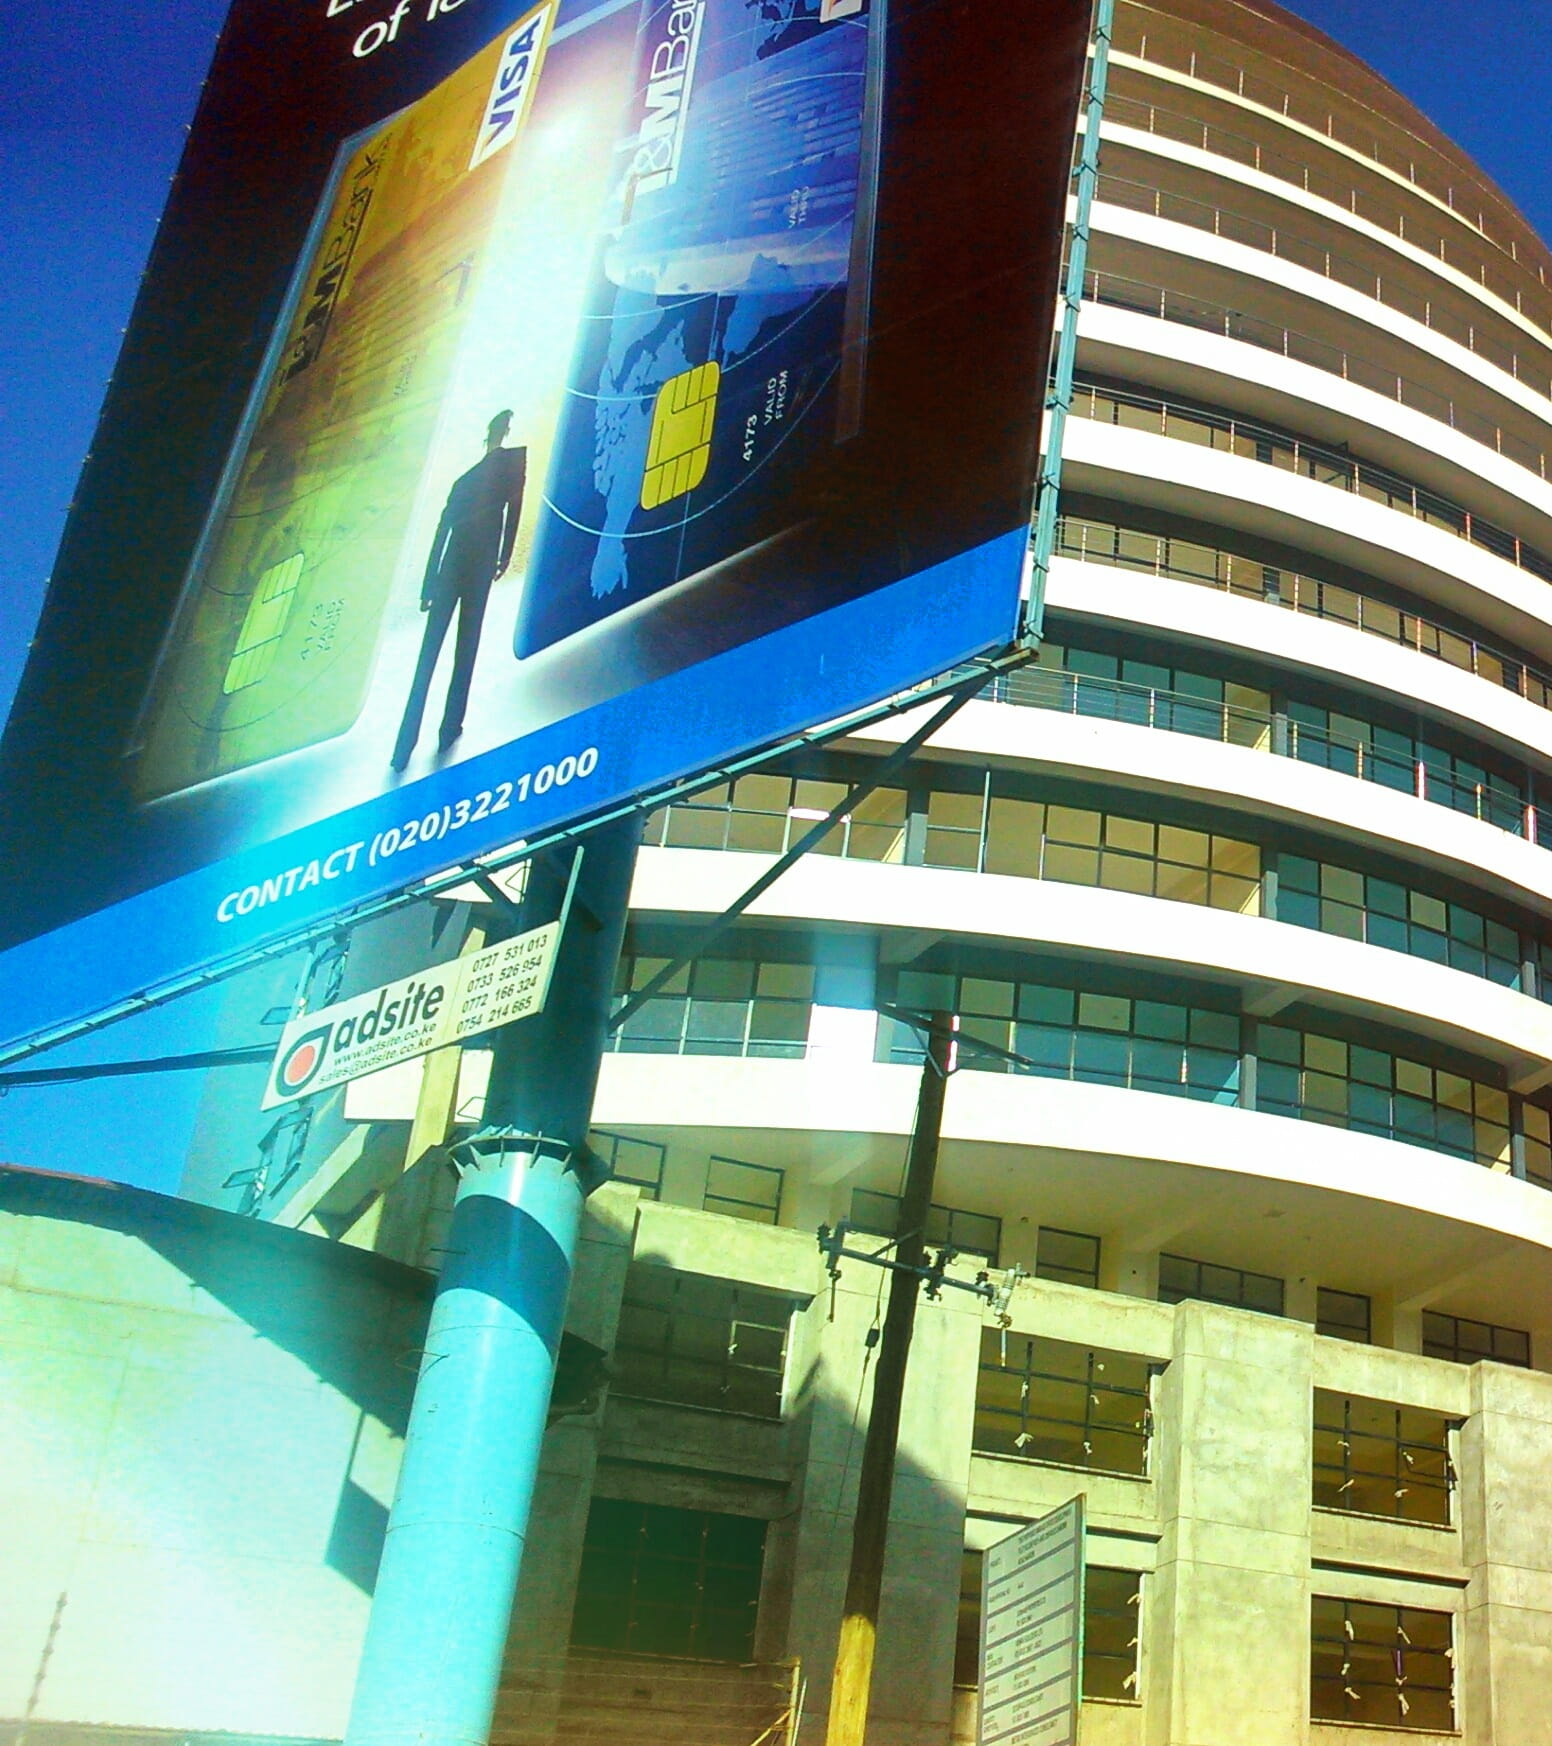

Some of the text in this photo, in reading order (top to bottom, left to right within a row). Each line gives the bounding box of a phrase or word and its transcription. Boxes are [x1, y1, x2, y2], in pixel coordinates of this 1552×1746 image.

[352, 0, 410, 58] of
[485, 15, 541, 147] VISA
[764, 377, 777, 426] VALID
[776, 370, 789, 420] FROM
[742, 414, 758, 461] 4173
[216, 747, 599, 923] CONTACT (020)3221000
[467, 954, 543, 993] 0733 526 954
[472, 934, 548, 973] 0727 531 013
[333, 981, 445, 1053] adsite
[462, 974, 538, 1014] 0772 166 324
[457, 1013, 483, 1034] 0754
[488, 1004, 510, 1023] 214
[318, 1037, 433, 1084] sales@adsite.co.ke
[334, 1023, 437, 1066] www.adsite.co.ke
